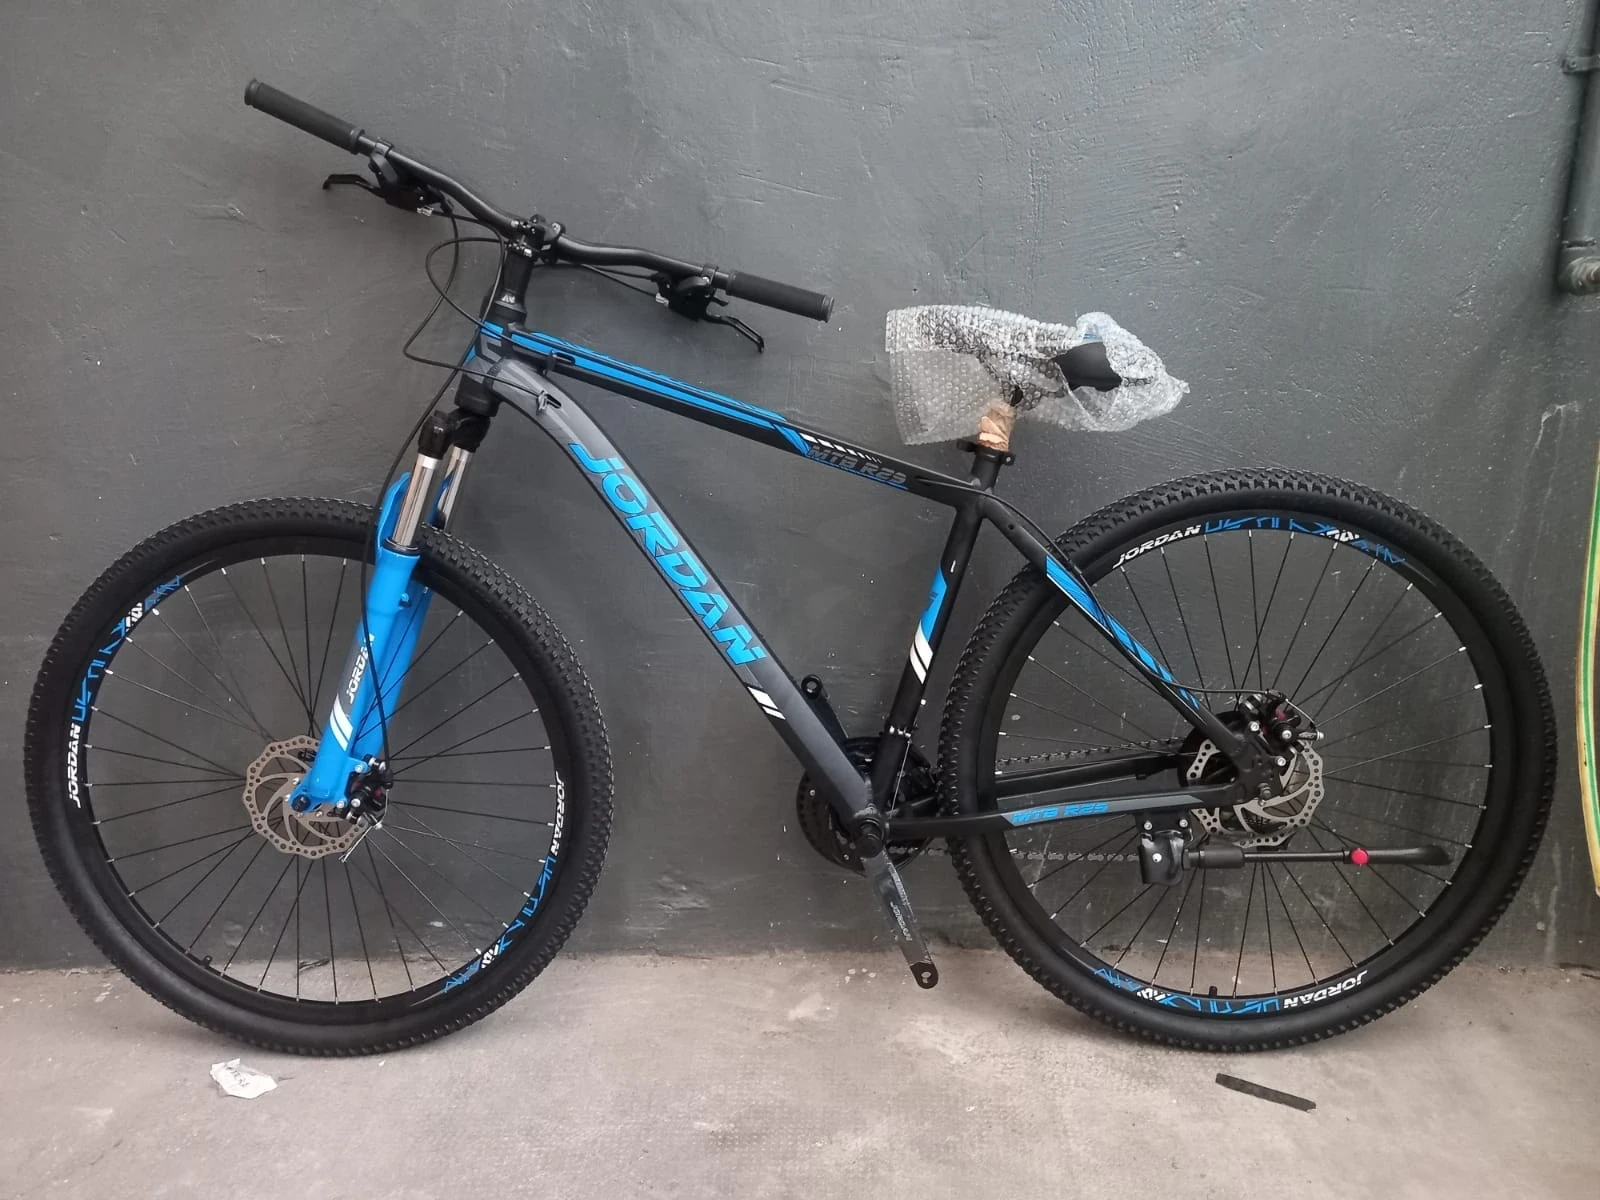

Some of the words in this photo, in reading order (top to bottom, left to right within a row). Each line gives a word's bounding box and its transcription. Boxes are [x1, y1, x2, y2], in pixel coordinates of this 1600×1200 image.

[808, 445, 858, 468] MTB
[567, 442, 768, 665] JORDAN
[1112, 524, 1201, 569] JORDAN
[67, 722, 82, 809] JORDAN
[550, 771, 565, 857] JORDAN
[1011, 807, 1059, 824] MTB
[1283, 969, 1368, 1010] JORDAN
